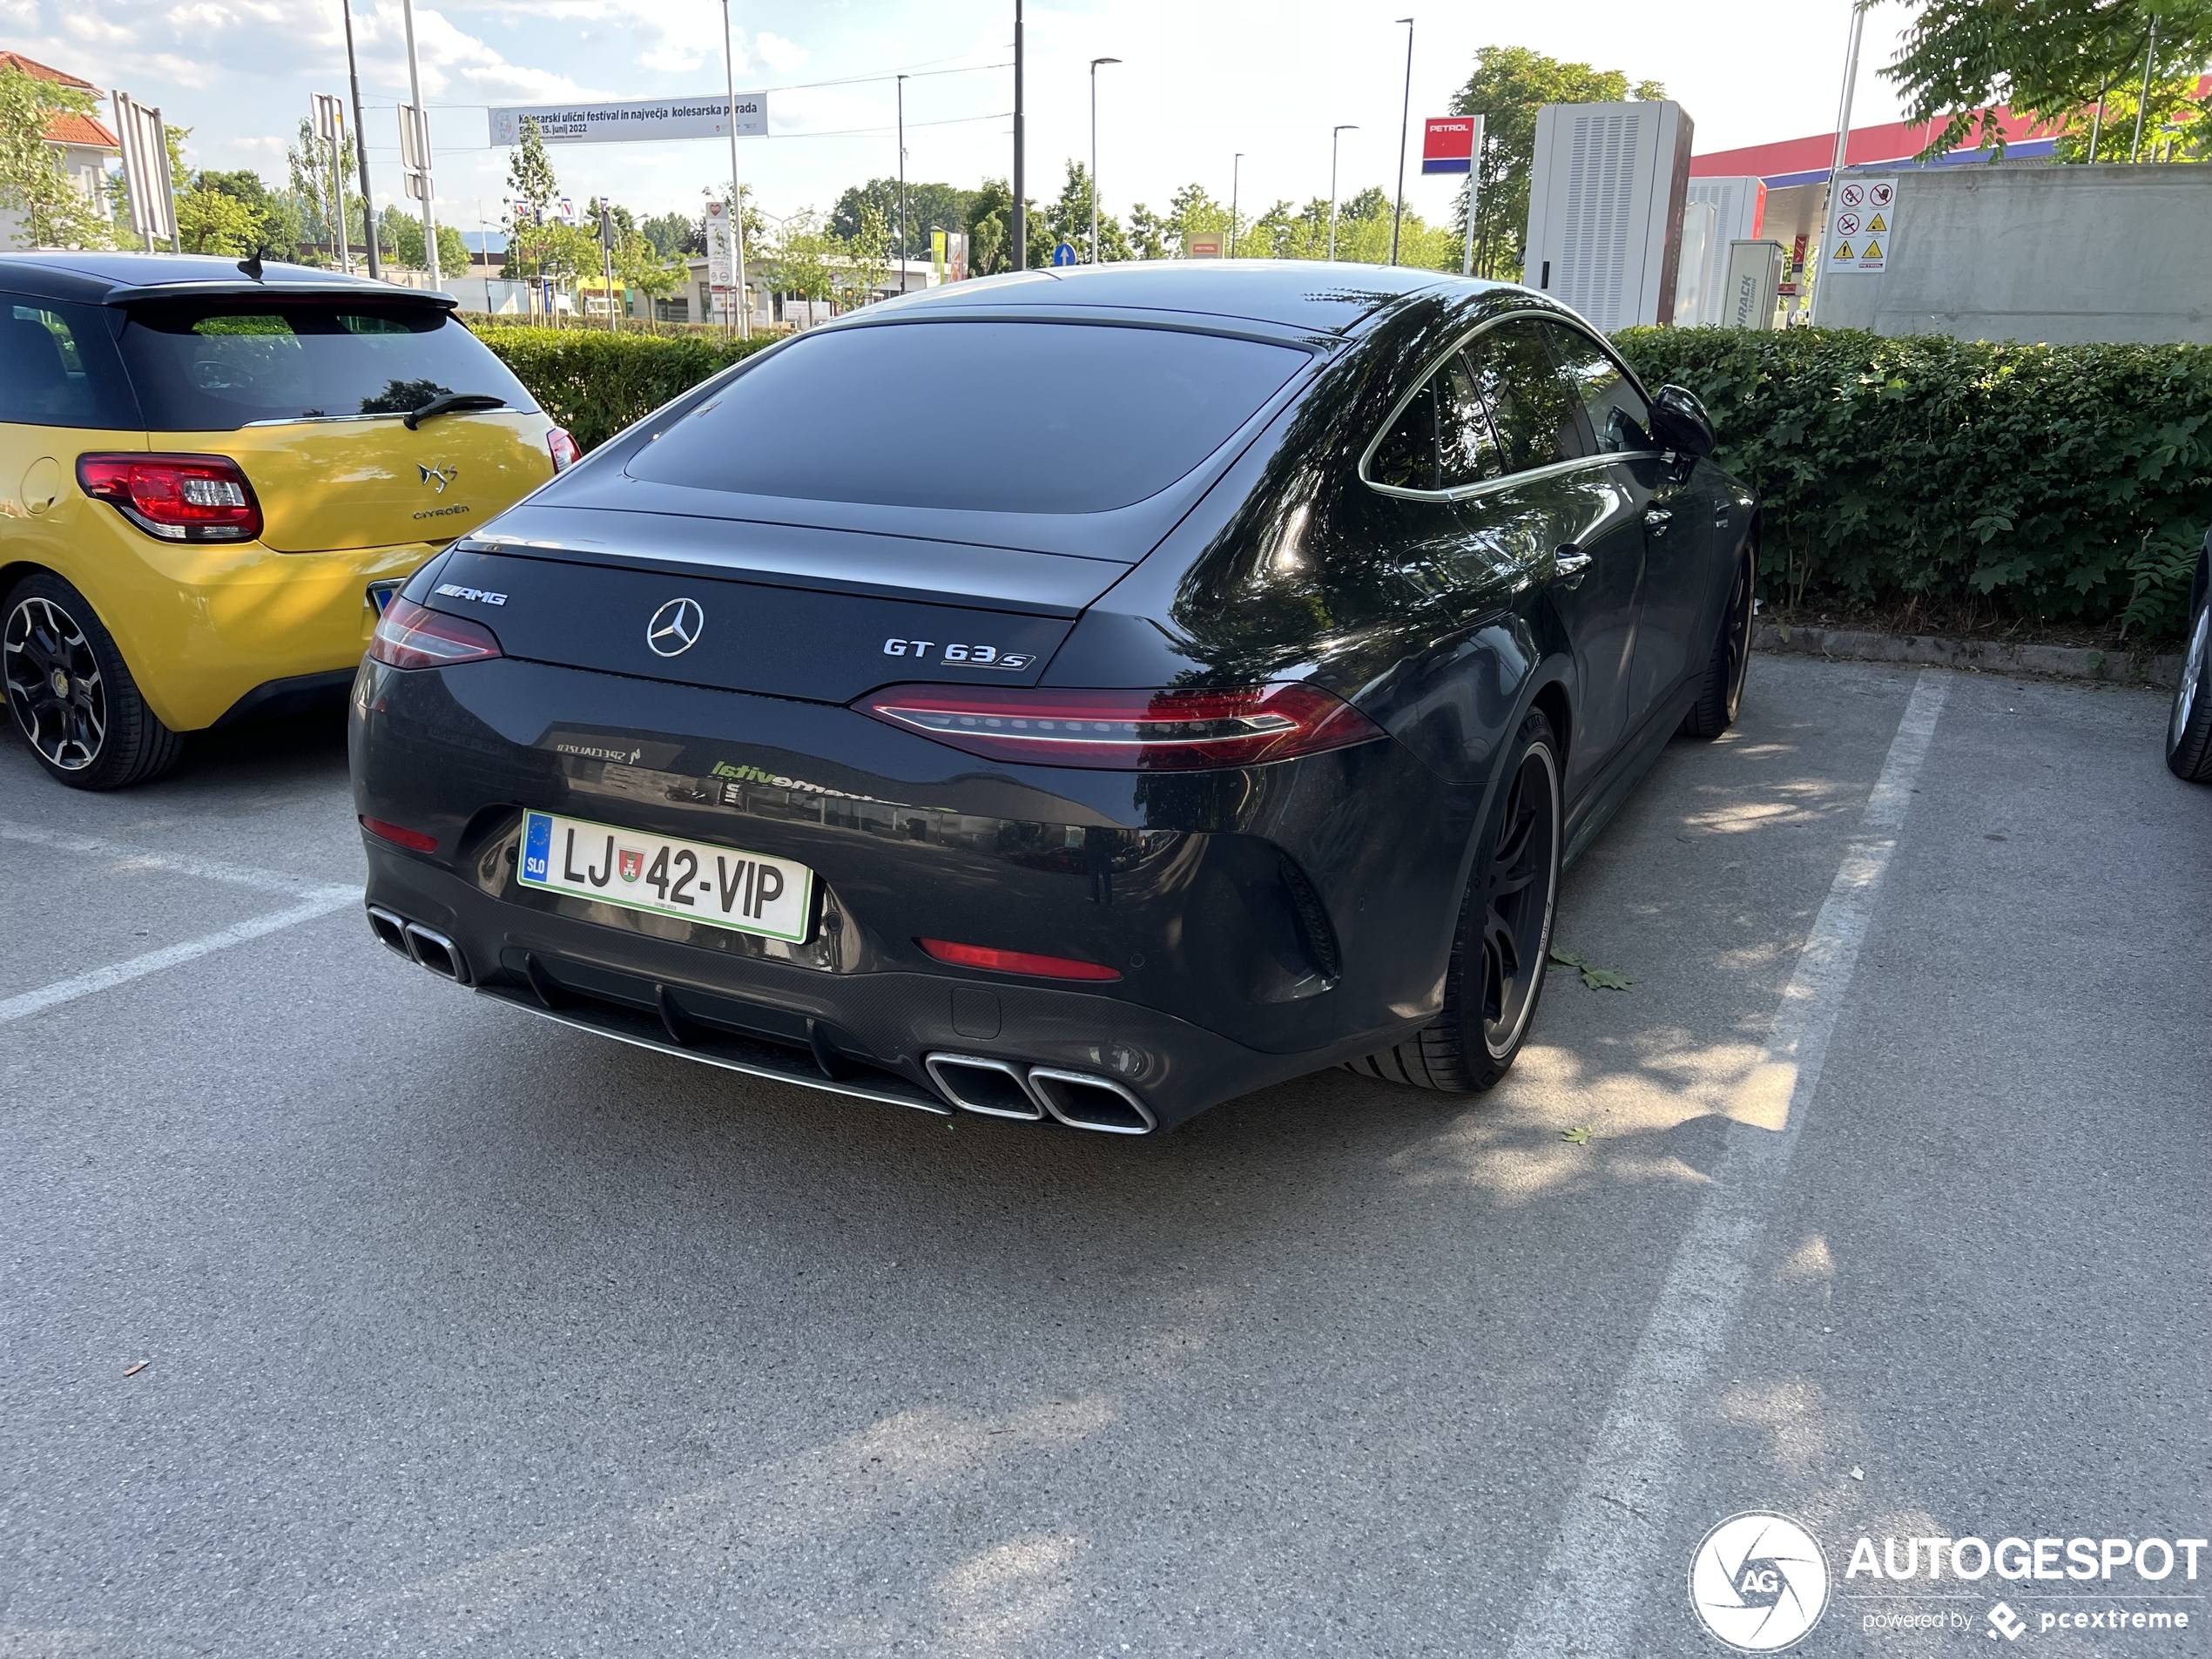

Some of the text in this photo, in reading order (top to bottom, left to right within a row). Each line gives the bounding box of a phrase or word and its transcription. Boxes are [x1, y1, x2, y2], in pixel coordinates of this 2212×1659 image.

[562, 111, 585, 123] ulični
[587, 110, 619, 122] festival
[621, 109, 629, 120] in
[631, 107, 668, 121] največja
[672, 105, 722, 118] kolesarska
[724, 102, 758, 117] prada
[542, 125, 552, 134] 15.
[552, 124, 569, 135] junij
[570, 124, 588, 133] 2022
[1429, 124, 1469, 132] PETROL
[454, 585, 509, 606] AMG
[883, 638, 935, 658] GT
[527, 857, 545, 874] SLO
[563, 827, 785, 920] LJ 42-VIP
